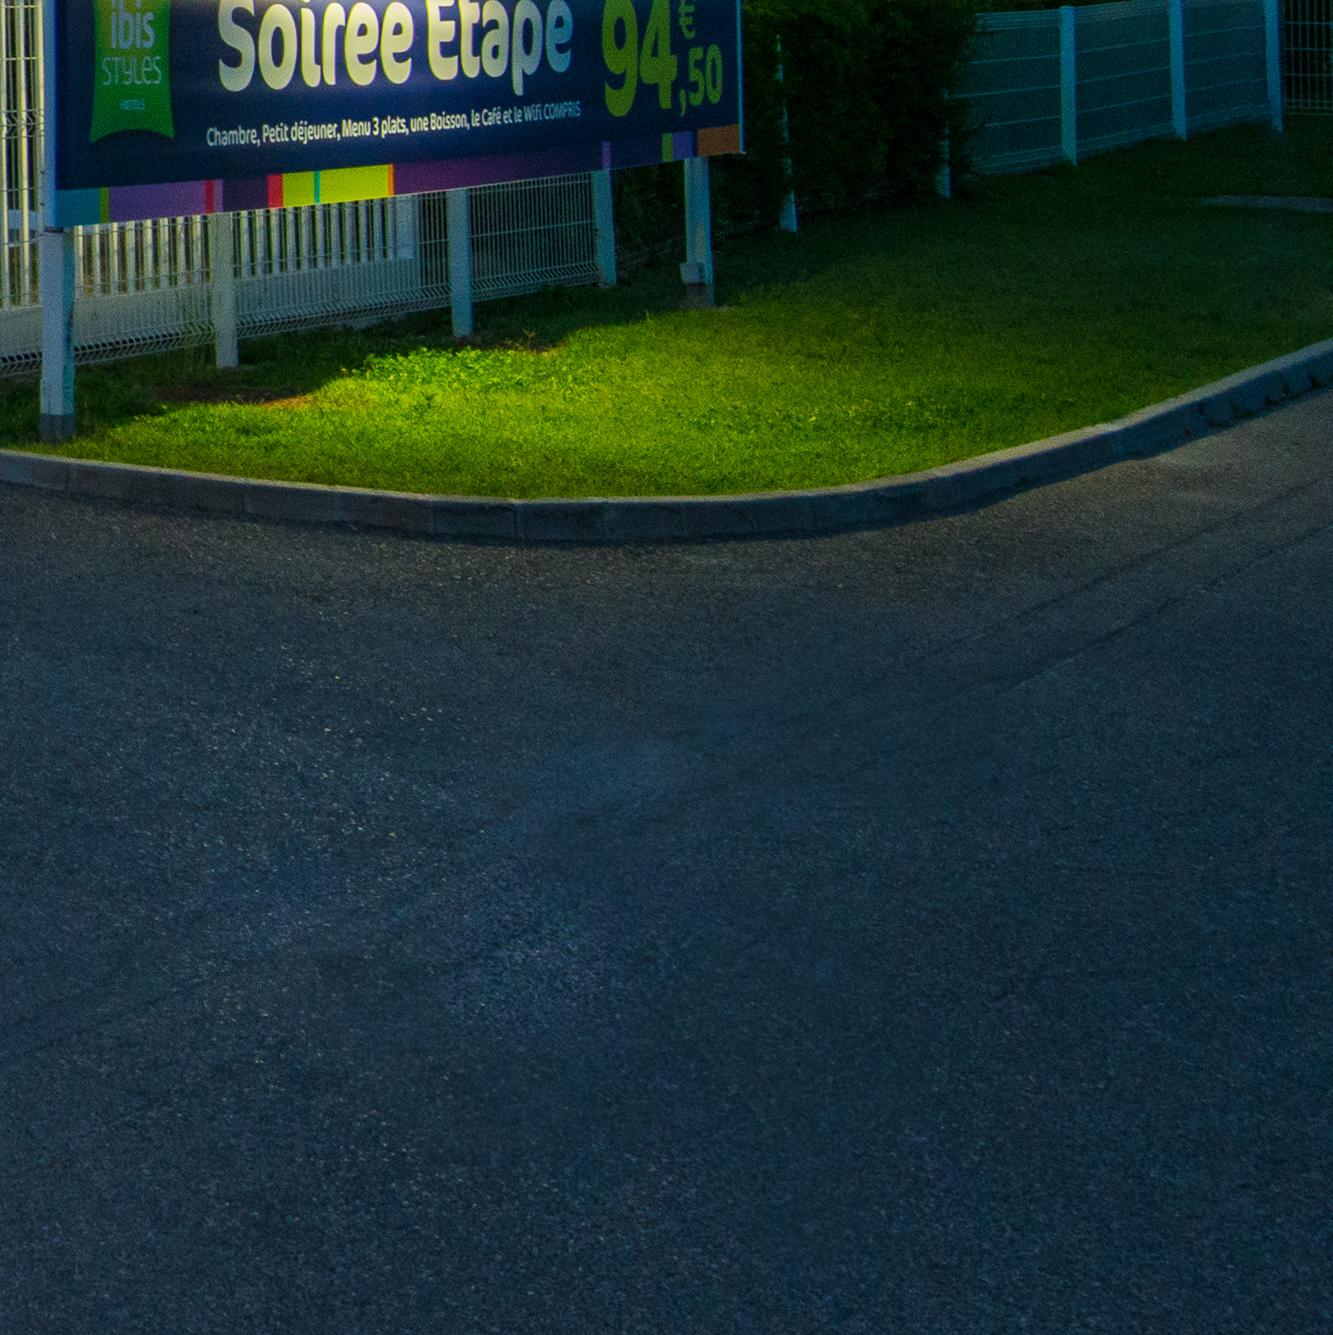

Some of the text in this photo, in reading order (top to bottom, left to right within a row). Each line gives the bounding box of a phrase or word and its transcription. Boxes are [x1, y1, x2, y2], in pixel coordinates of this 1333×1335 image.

[111, 0, 155, 49] ibis
[206, 125, 261, 147] Chambre,
[262, 122, 289, 143] Petit
[290, 120, 341, 145] déjeuner,
[342, 119, 371, 138] Menu
[372, 117, 380, 135] 3
[381, 115, 409, 138] plats,
[410, 116, 429, 132] une
[430, 111, 471, 130] Boisson,
[471, 109, 480, 127] le
[482, 106, 501, 125] Café
[503, 108, 513, 124] et
[513, 105, 523, 123] le
[543, 100, 581, 120] COMPRIS
